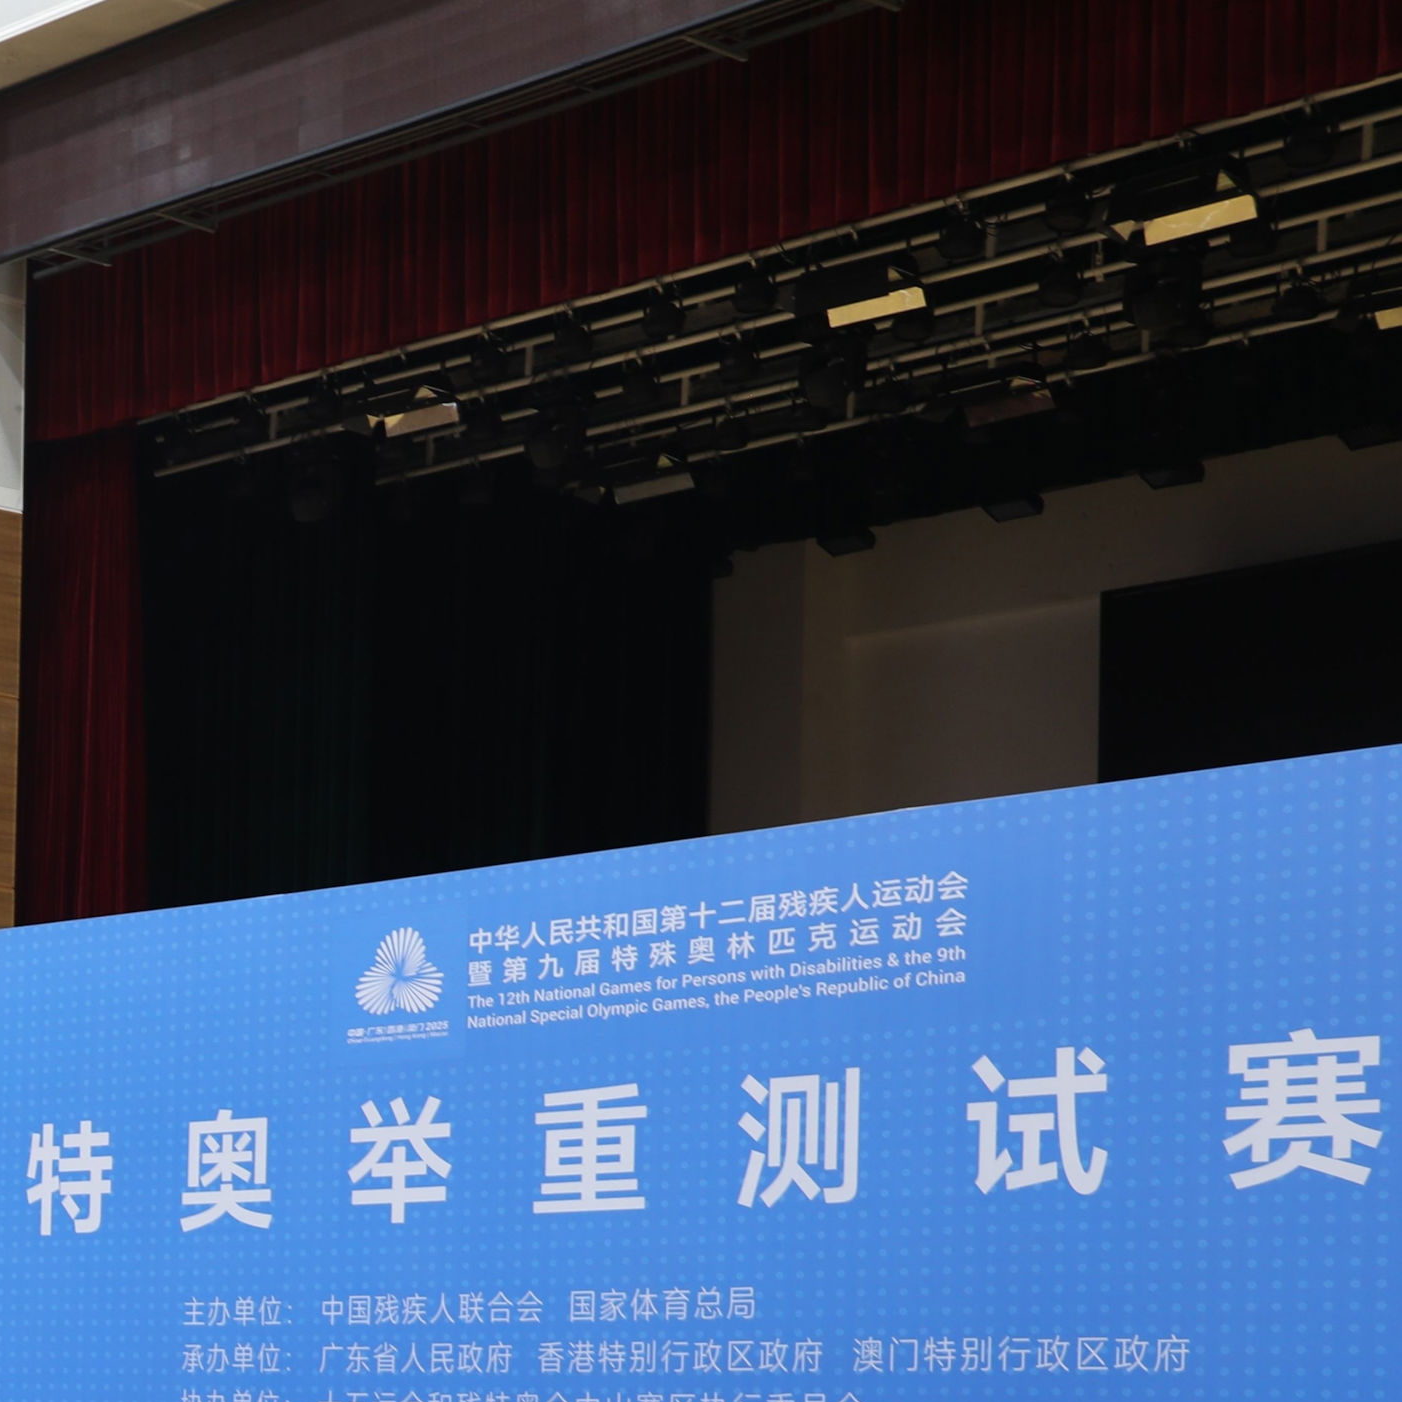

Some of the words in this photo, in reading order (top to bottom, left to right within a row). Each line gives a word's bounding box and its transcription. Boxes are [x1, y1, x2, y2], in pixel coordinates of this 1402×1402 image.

[468, 870, 969, 954] 中华人民共和国第十二届残疾人运动会
[467, 907, 967, 988] 暨第九届特殊奥林匹克运动会
[467, 994, 494, 1009] The
[498, 990, 530, 1007] 12th
[533, 981, 596, 1003] National
[599, 980, 652, 997] Games
[656, 975, 677, 991] for
[681, 970, 746, 989] Persons
[750, 963, 785, 981] with
[789, 954, 882, 978] Disabilities
[886, 952, 900, 967] &
[904, 949, 932, 966] the
[936, 945, 966, 963] 9th
[467, 1009, 527, 1030] National
[530, 1004, 583, 1026] Special
[586, 998, 649, 1023] Olympic
[652, 995, 710, 1013] Games,
[714, 990, 740, 1007] the
[744, 983, 812, 1005] People's
[815, 975, 889, 998] Republic
[893, 972, 912, 989] of
[915, 967, 966, 986] China
[25, 1029, 1384, 1237] 特奥举重测试赛
[321, 1290, 544, 1325] 中国残疾人联合会
[568, 1286, 756, 1323] 国家体育总局
[318, 1340, 513, 1375] 广东省人民政府
[537, 1337, 824, 1375] 香港特别行政区政府
[851, 1333, 1191, 1373] 澳门特别行政区政府
